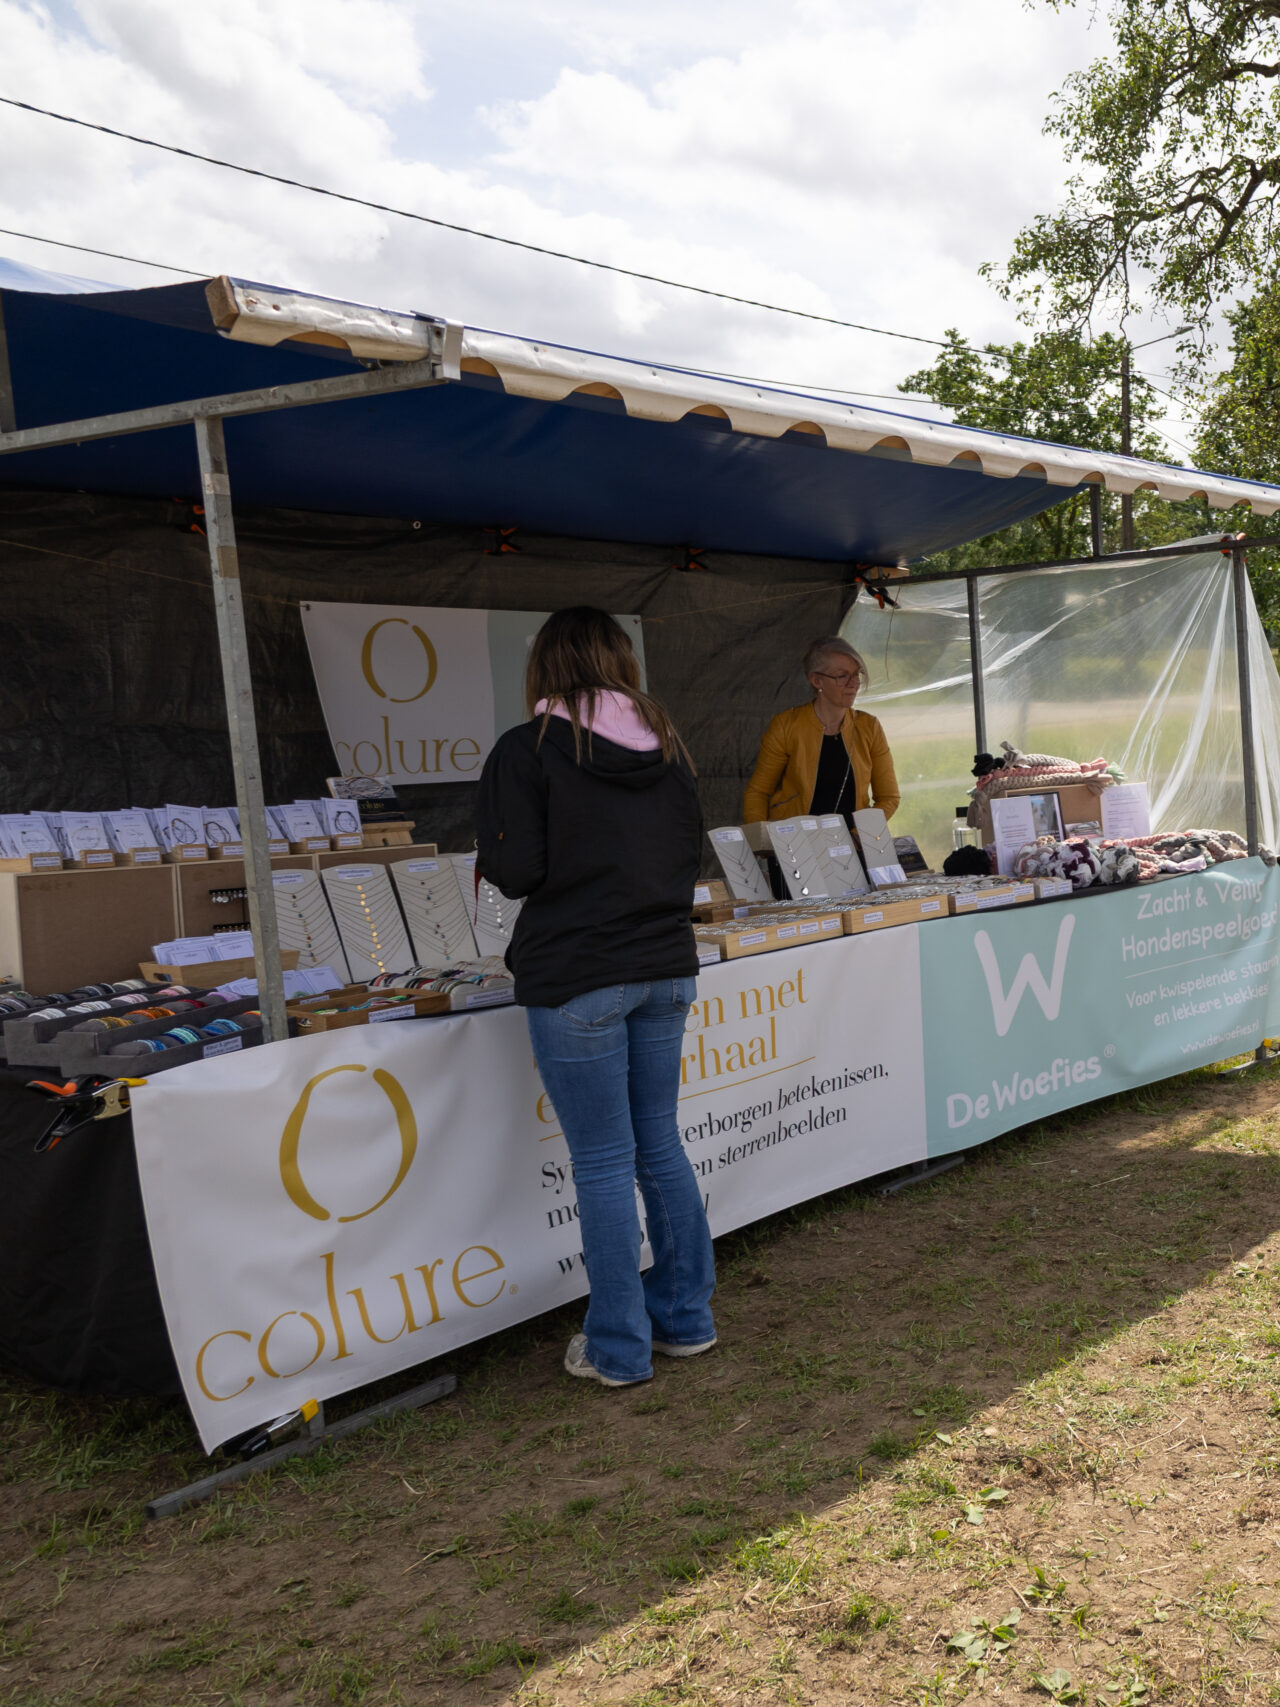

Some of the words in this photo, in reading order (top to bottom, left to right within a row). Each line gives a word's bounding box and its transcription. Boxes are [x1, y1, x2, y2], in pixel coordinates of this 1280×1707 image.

[1137, 887, 1191, 920] Zacht
[1195, 886, 1208, 908] &
[738, 968, 809, 1020] met
[974, 913, 1076, 1037] W
[1125, 990, 1157, 1009] Voor
[1159, 968, 1237, 1000] kwispelende
[1154, 1011, 1170, 1026] en
[1172, 998, 1222, 1022] lekkere
[680, 1016, 779, 1085] rhaal
[777, 1064, 889, 1111] betekenissen,
[718, 1106, 847, 1169] sterrenbeelden
[195, 1245, 506, 1402] colure
